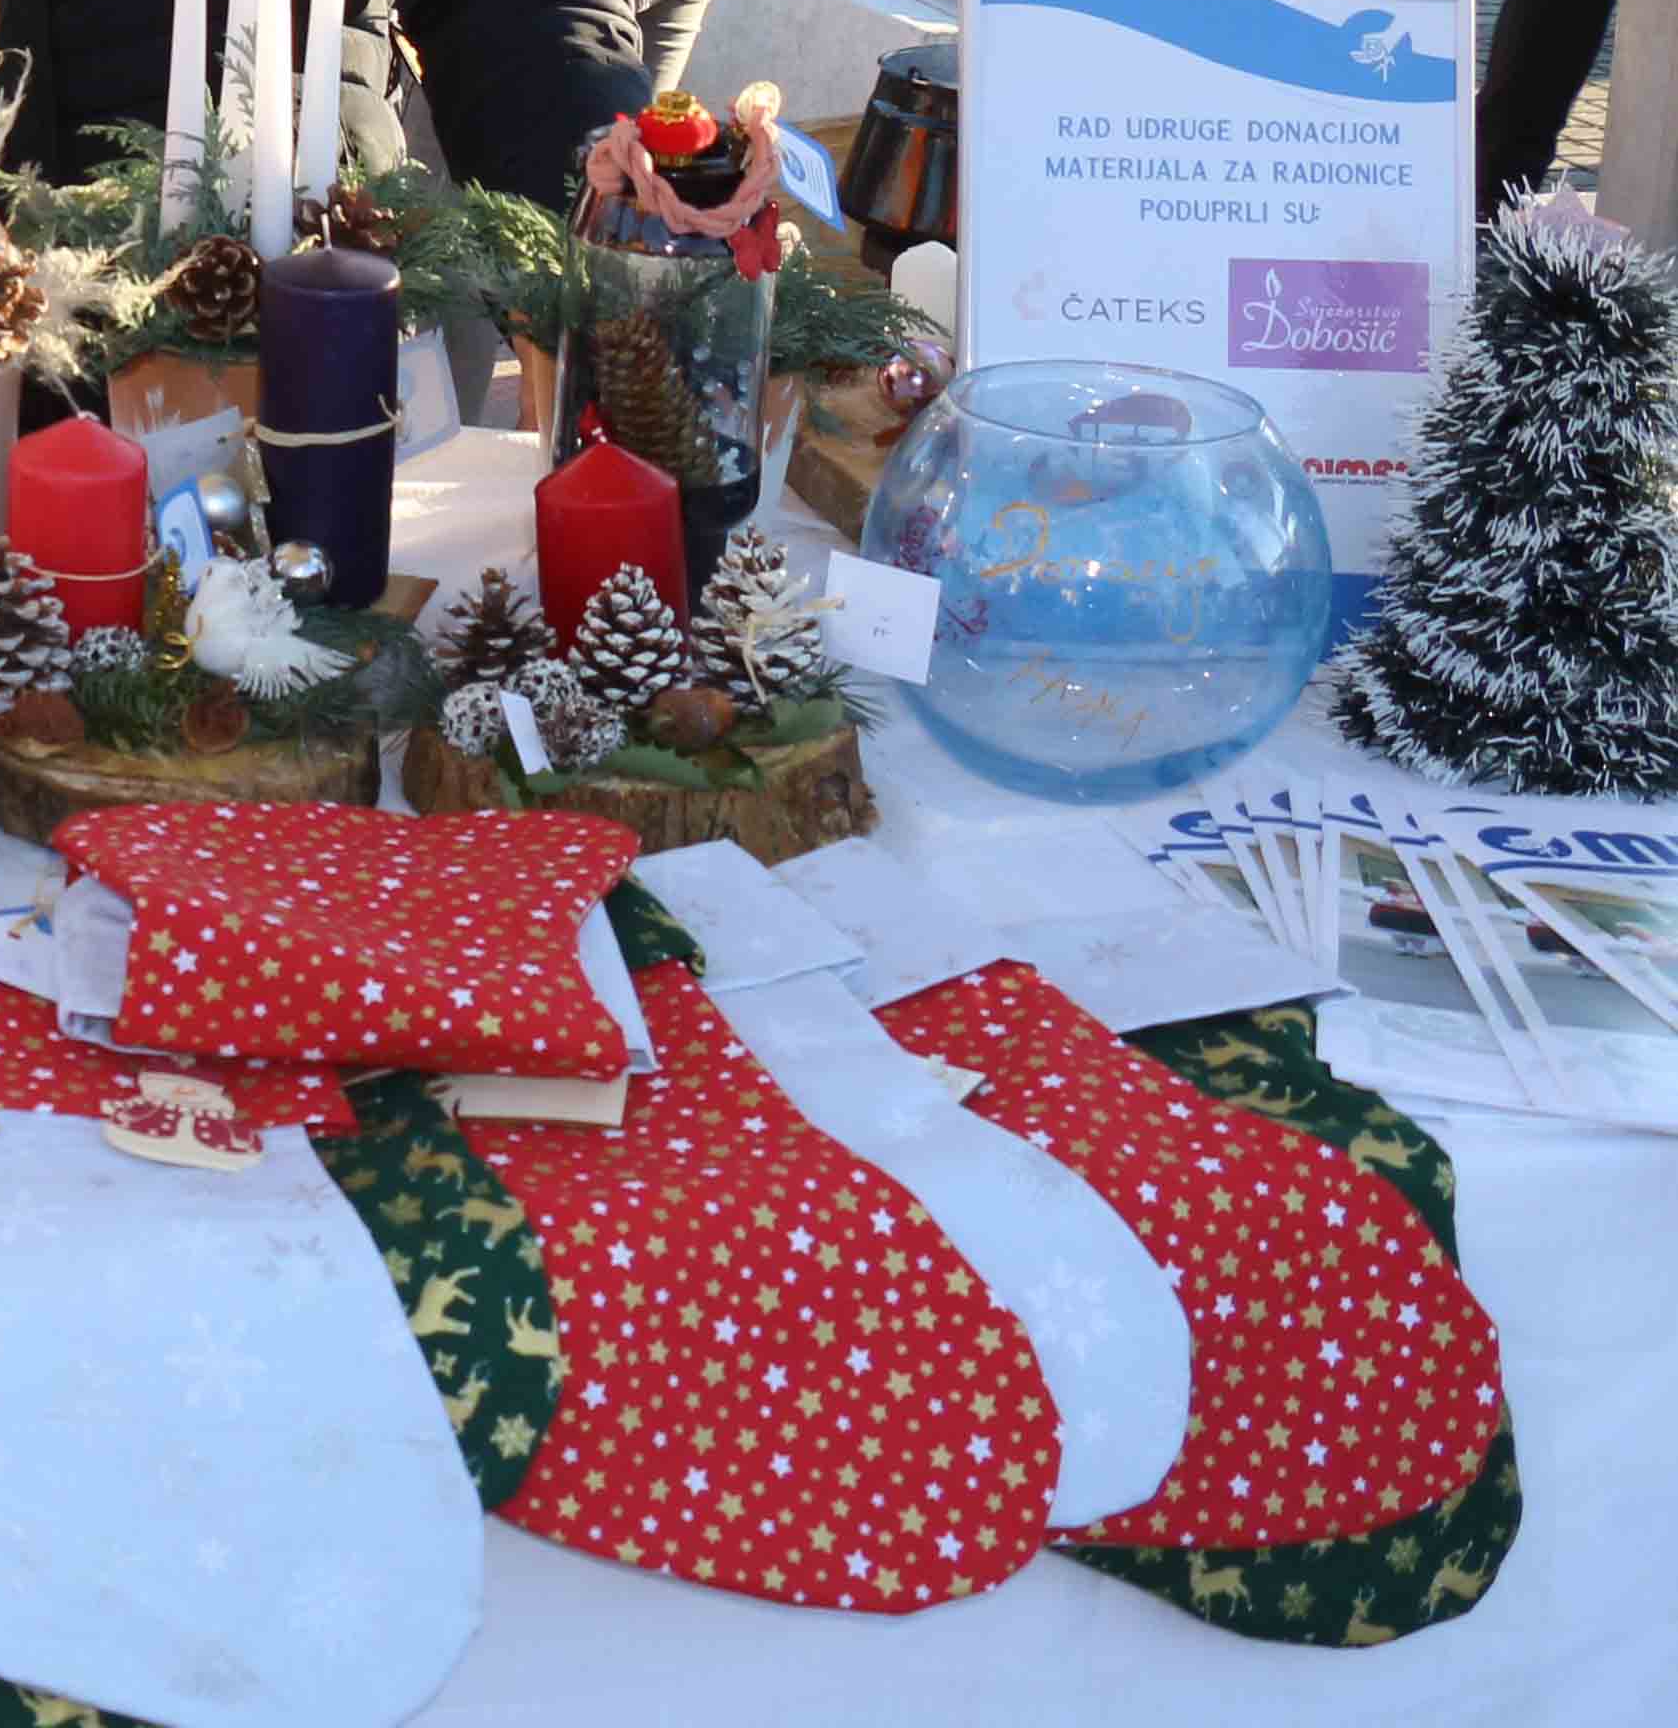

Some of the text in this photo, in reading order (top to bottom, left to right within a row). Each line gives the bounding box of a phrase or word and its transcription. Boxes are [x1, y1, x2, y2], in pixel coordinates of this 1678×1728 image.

[1057, 116, 1401, 145] RAD UDRUGE DONACIJOM
[1044, 156, 1414, 186] MATERIJALA ZA RADIONICE
[1139, 198, 1322, 224] PODUPRLI SU:
[1060, 291, 1206, 324] ČATEKS
[1241, 298, 1398, 353] Dobošić
